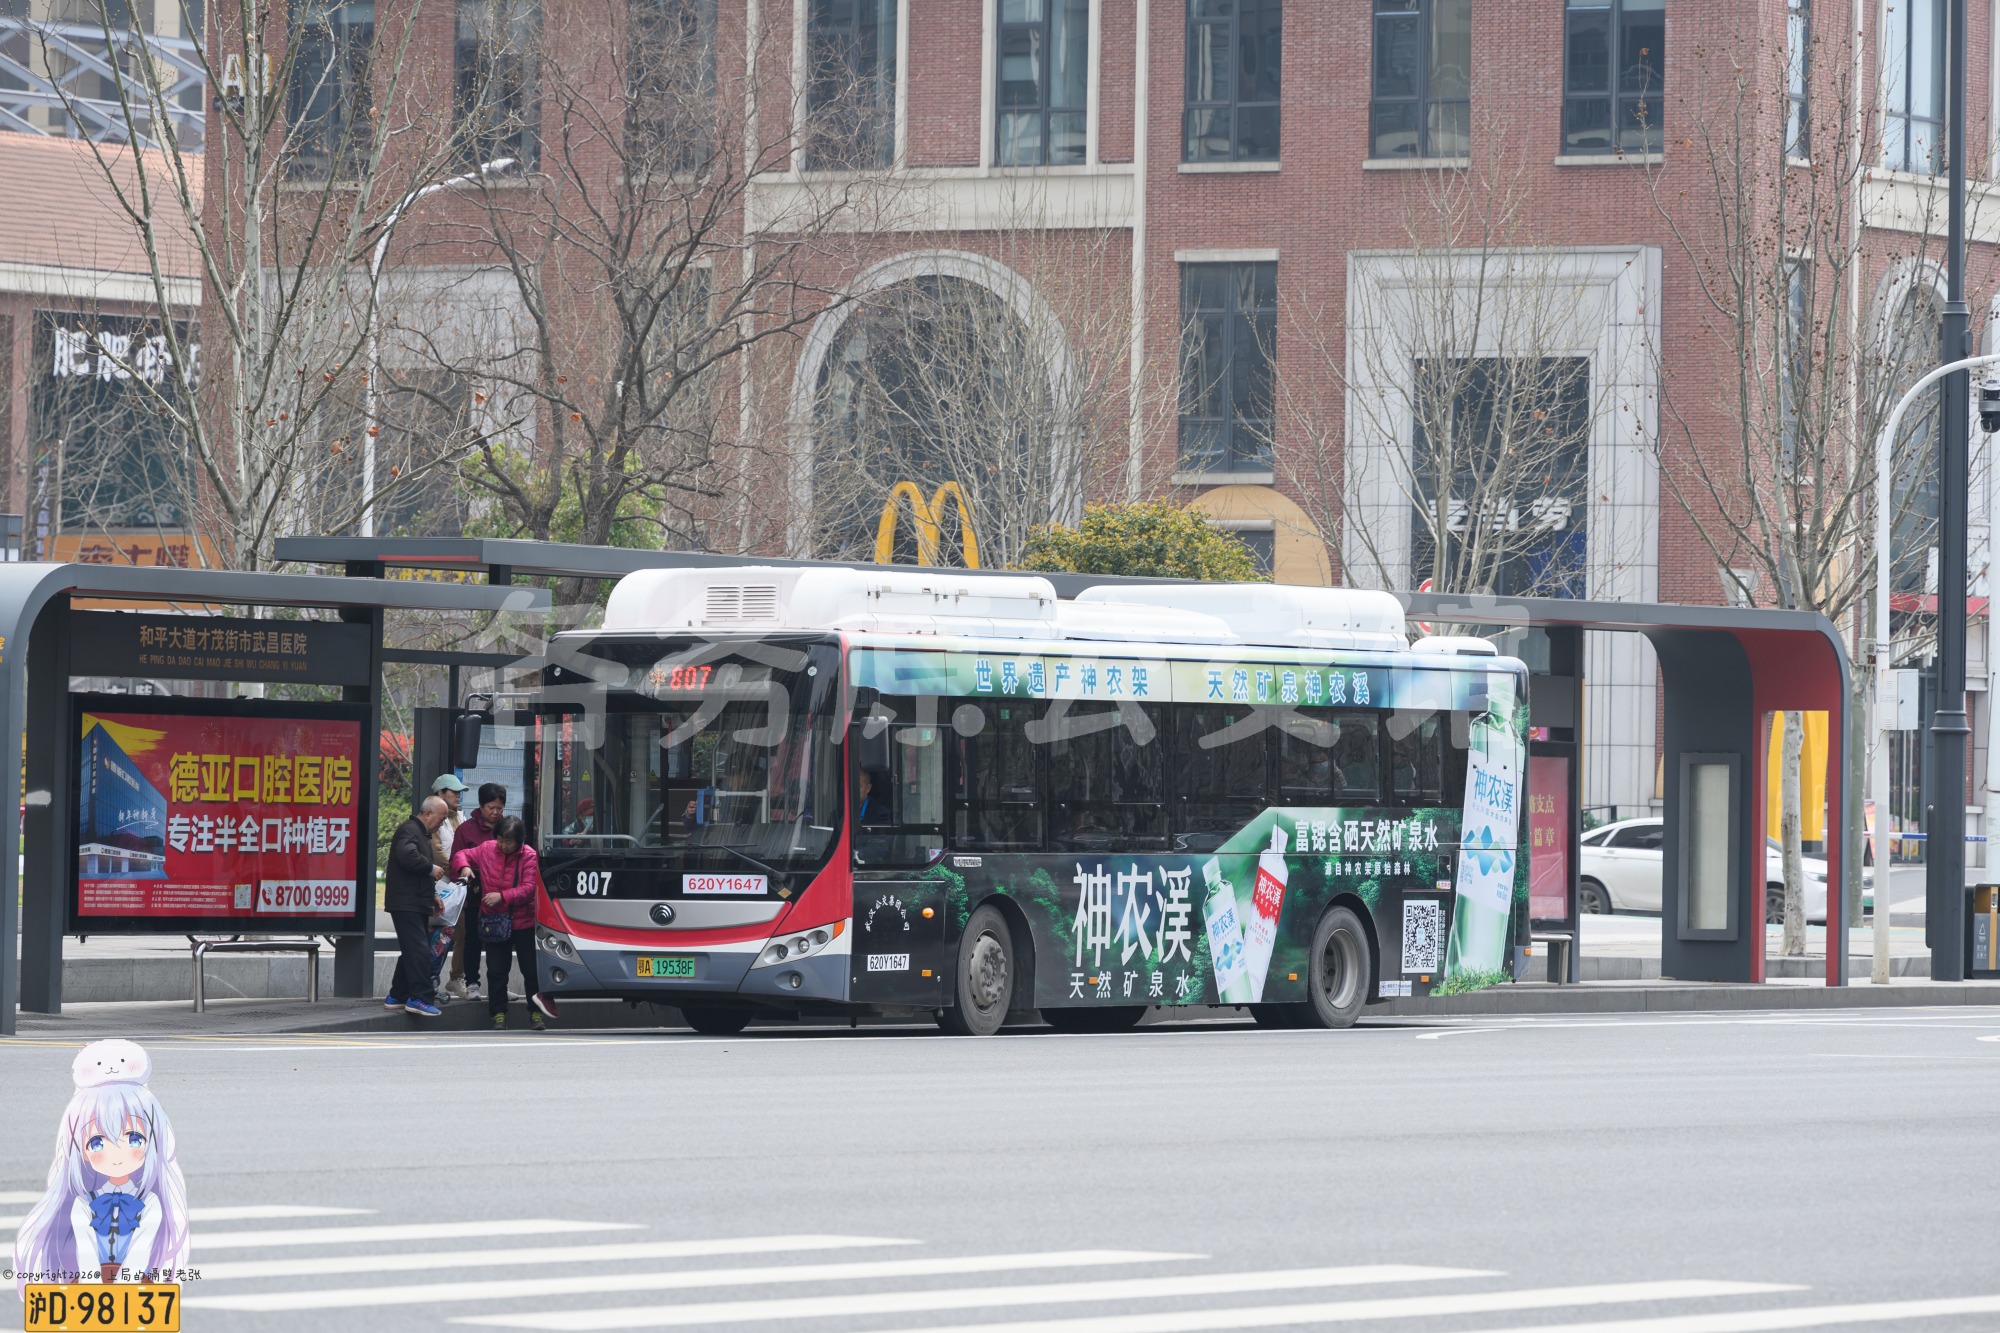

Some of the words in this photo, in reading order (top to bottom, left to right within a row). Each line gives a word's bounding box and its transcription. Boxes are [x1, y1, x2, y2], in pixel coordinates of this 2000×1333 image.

[139, 625, 307, 655] 和平大道才茂街市武昌医院
[139, 654, 148, 664] HE
[150, 655, 164, 665] PING
[167, 655, 176, 665] DA
[179, 656, 191, 666] DAO
[194, 656, 204, 667] CAI
[206, 657, 220, 668] MAO
[223, 658, 232, 668] JIE
[234, 658, 244, 669] SHI
[247, 659, 257, 669] WU
[259, 659, 279, 670] CHANG
[283, 660, 288, 670] YI
[291, 660, 307, 671] YUAN
[670, 666, 712, 691] 807
[974, 658, 1150, 697] 世界遗产神农架
[1207, 670, 1371, 705] 天然矿泉神农溪
[169, 751, 352, 806] 德亚口腔医院
[1473, 767, 1514, 815] 神农溪
[167, 813, 351, 855] 专注半全口种植牙
[1295, 819, 1439, 852] 富锶含硒天然矿泉水
[576, 871, 612, 896] 807
[1325, 861, 1411, 876] 源自神农架原始森林
[275, 885, 310, 907] 8700
[314, 885, 350, 907] 9999
[688, 877, 762, 891] 620Y1647
[1072, 862, 1192, 968] 神农溪
[869, 955, 907, 970] 620Y1647
[1069, 969, 1191, 999] 天然矿泉水
